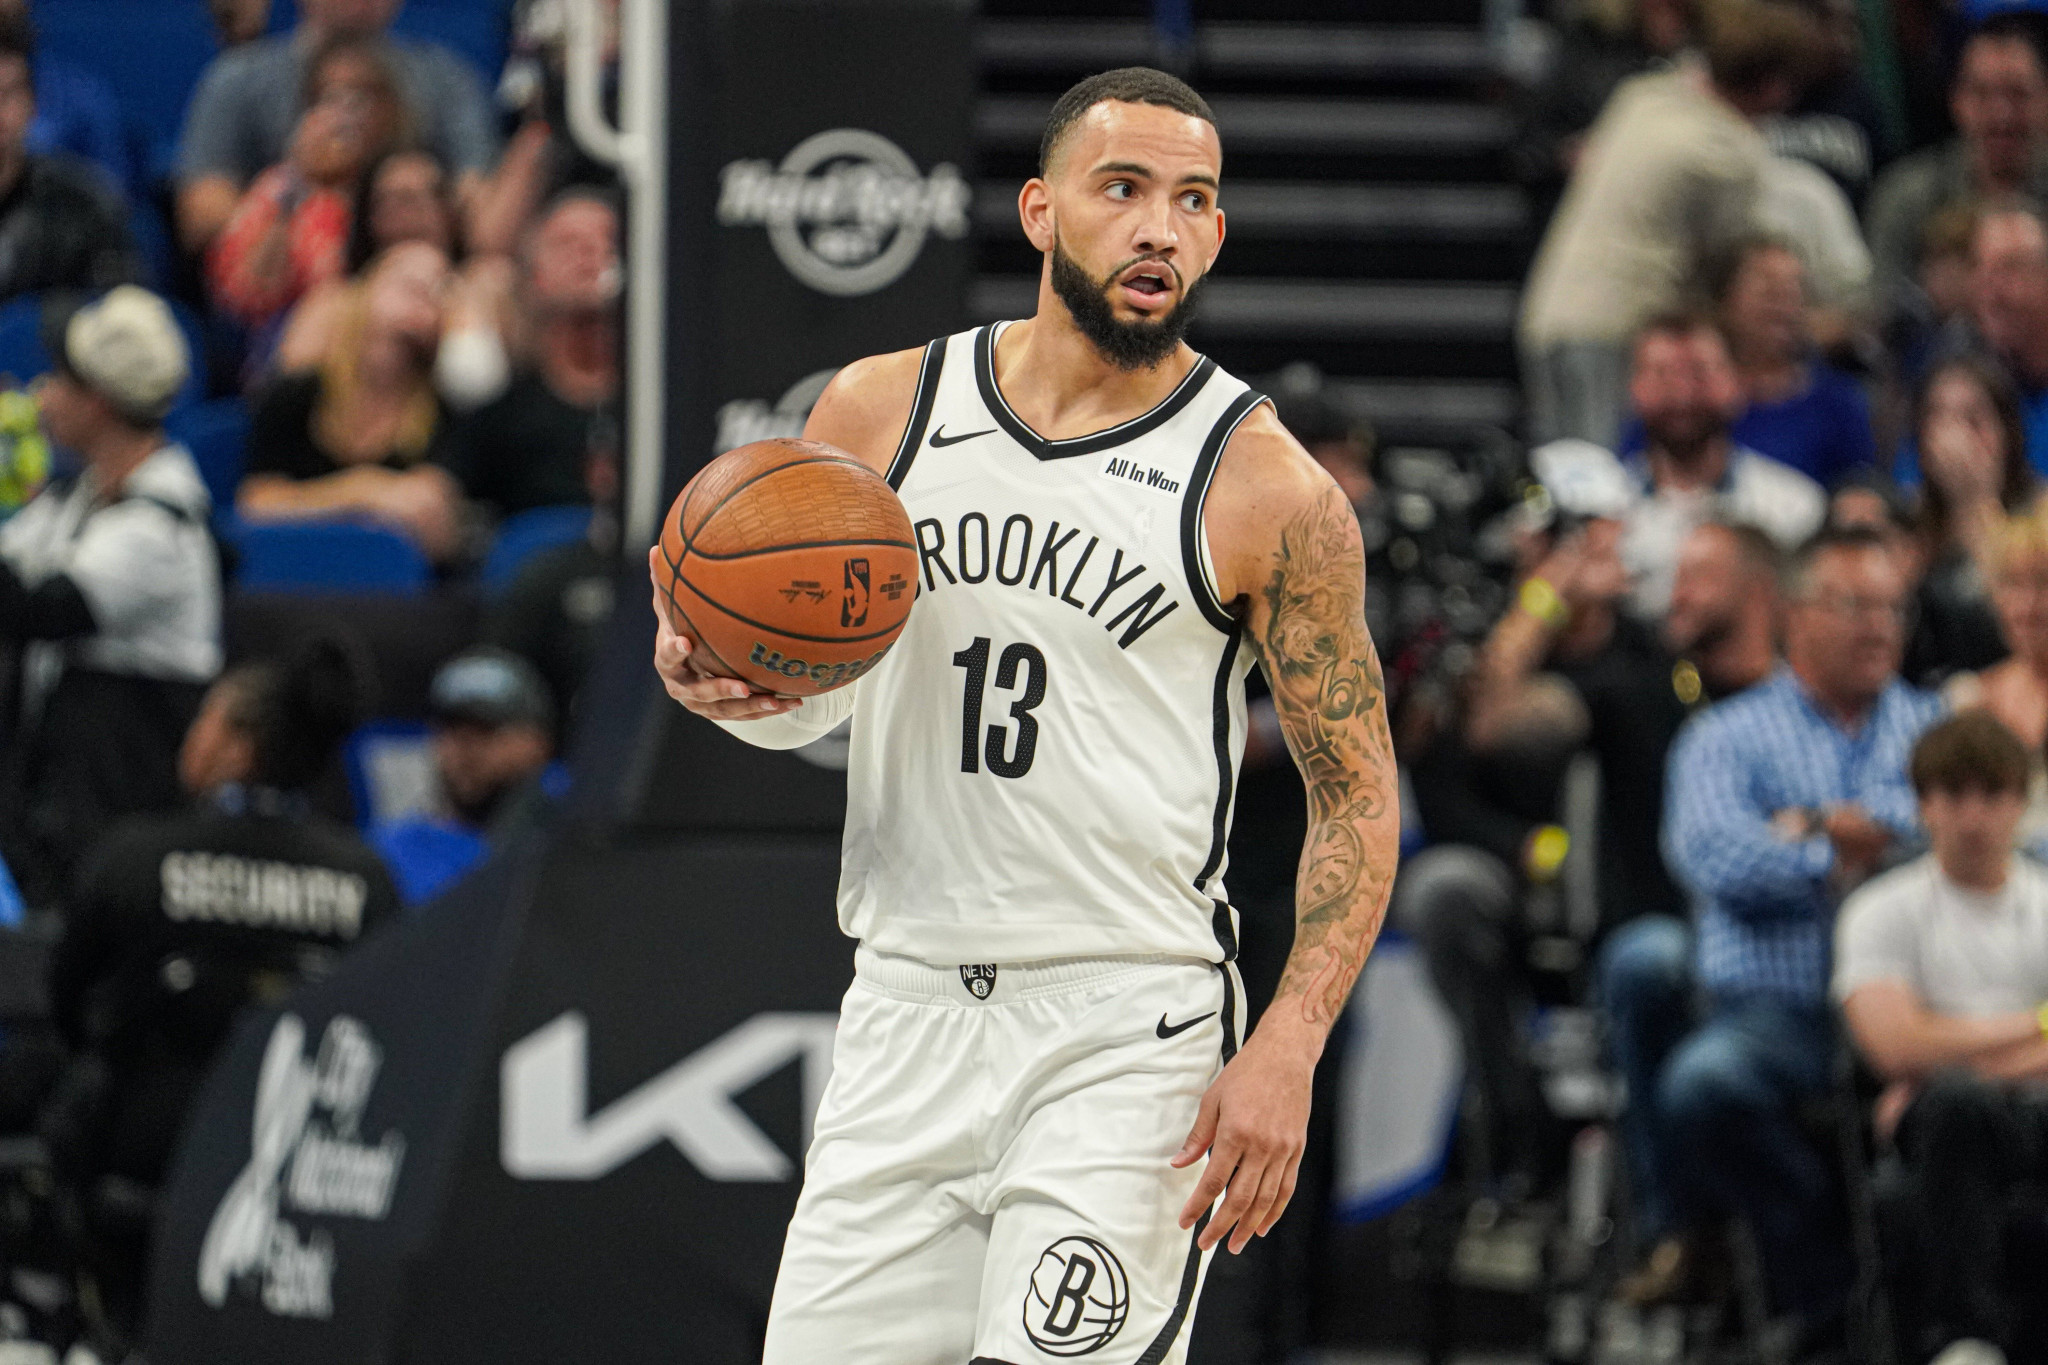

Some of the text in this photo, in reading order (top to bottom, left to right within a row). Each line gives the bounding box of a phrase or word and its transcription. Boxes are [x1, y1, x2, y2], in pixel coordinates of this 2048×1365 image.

[1105, 457, 1180, 494] All In Won
[914, 511, 1180, 650] ROOKLYN
[952, 636, 1048, 779] 13
[160, 850, 367, 941] SECURITY
[962, 964, 995, 980] NETS
[1042, 1252, 1097, 1338] B
